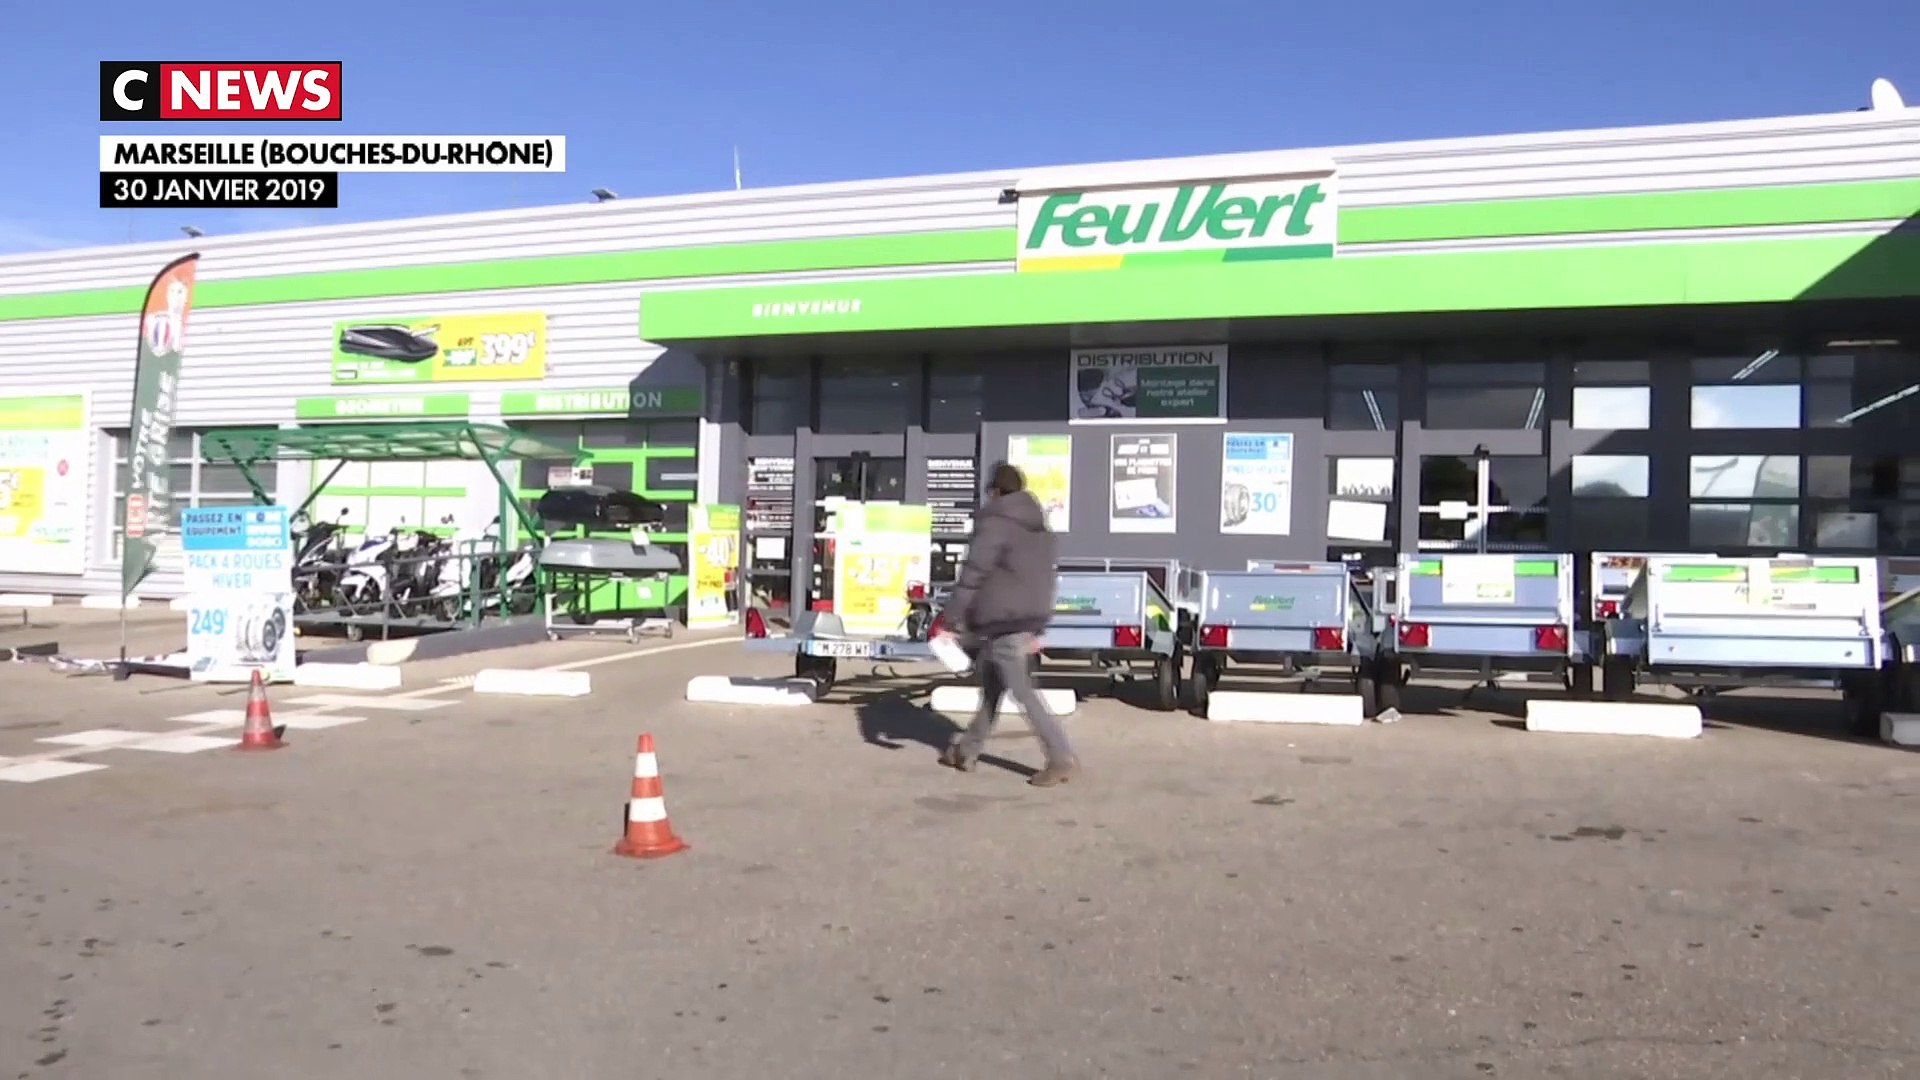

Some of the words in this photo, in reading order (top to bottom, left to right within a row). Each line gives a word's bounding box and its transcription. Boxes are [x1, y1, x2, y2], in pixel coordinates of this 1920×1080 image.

[752, 299, 862, 318] BIENVENUE
[1077, 352, 1214, 367] DISTRIBUTION
[186, 513, 223, 524] PASSEZ
[228, 512, 243, 522] EN
[189, 554, 217, 569] PACK
[222, 555, 229, 569] 4
[233, 553, 282, 569] ROUES
[212, 573, 252, 588] HIVER
[832, 644, 852, 655] 278
